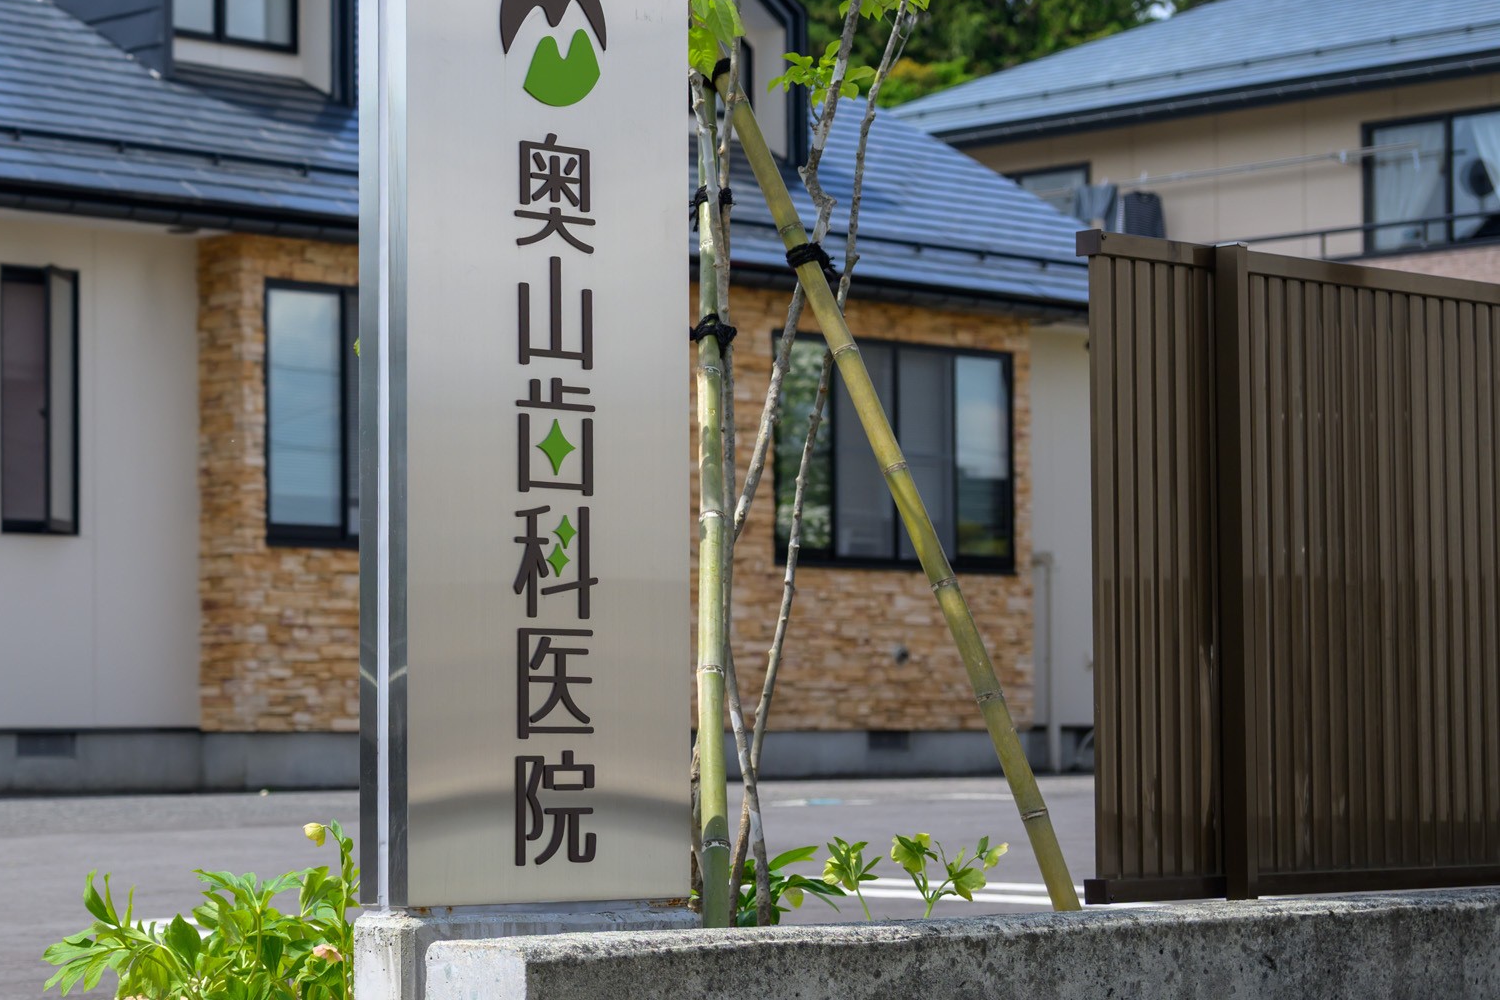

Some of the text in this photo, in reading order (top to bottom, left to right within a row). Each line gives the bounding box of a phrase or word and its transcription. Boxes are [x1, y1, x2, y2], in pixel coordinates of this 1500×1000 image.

[513, 132, 598, 866] 奥山歯科医院
